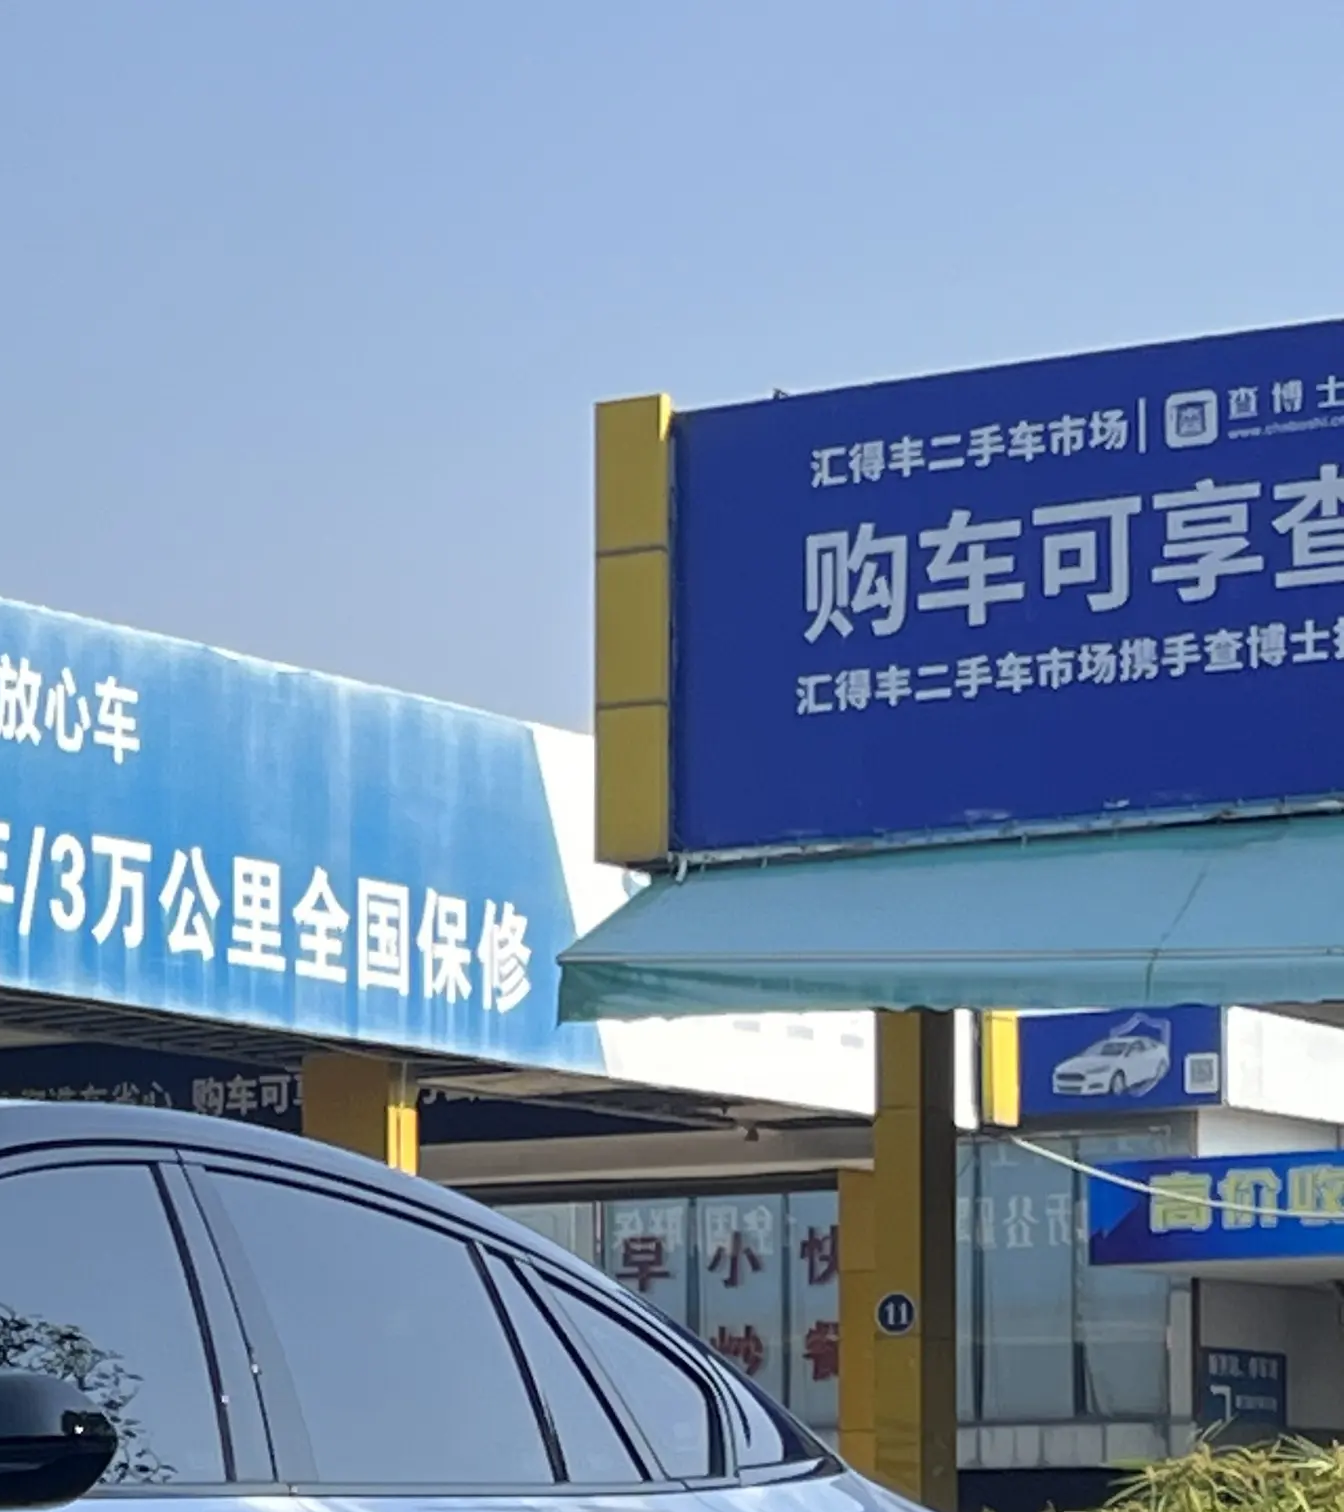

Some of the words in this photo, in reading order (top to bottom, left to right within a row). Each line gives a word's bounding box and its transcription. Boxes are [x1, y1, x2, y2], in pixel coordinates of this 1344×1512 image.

[811, 410, 1128, 489] 汇得丰二手车市场
[192, 1073, 304, 1116] 购车可
[885, 1301, 909, 1326] 11
